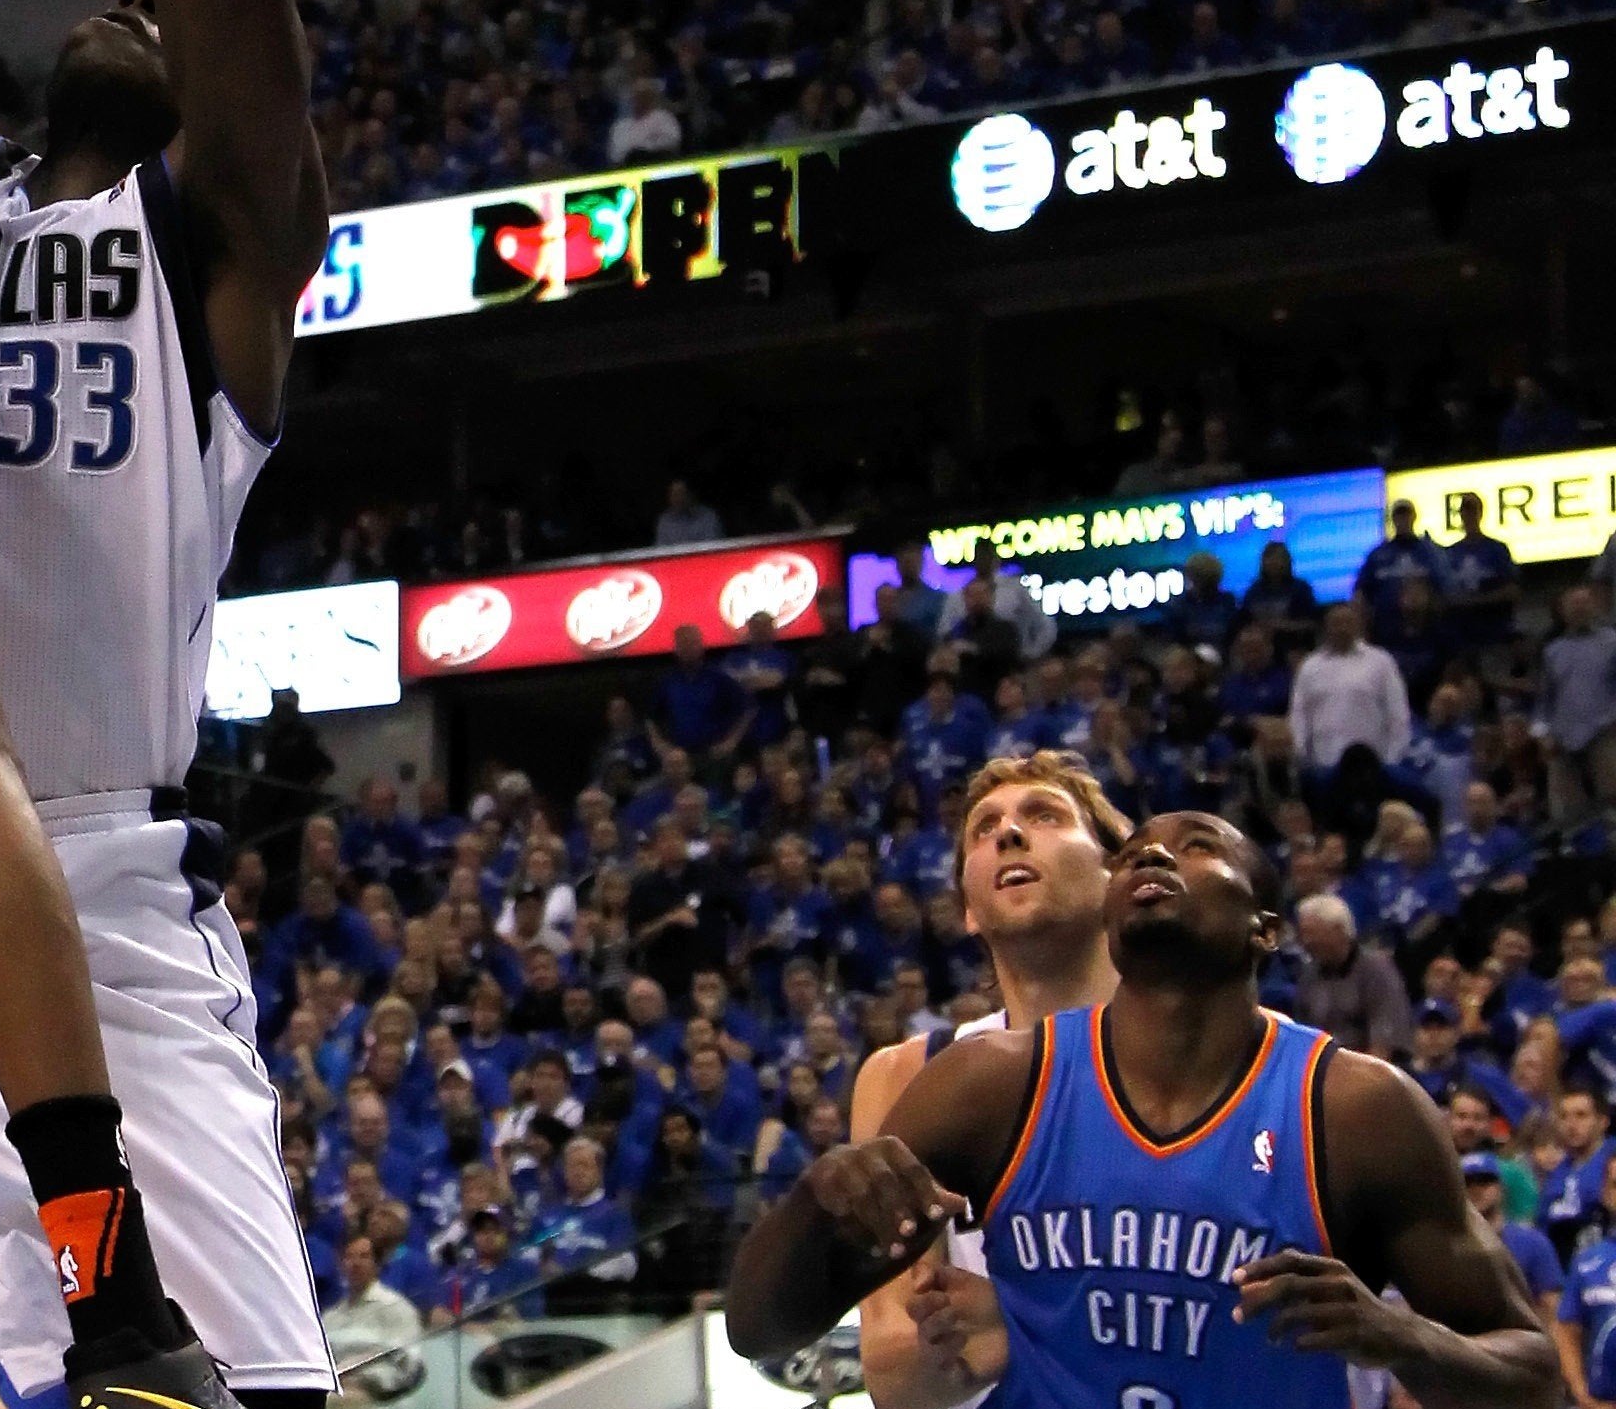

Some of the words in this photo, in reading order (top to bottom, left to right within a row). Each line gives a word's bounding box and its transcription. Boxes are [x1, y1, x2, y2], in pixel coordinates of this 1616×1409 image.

[1396, 46, 1570, 148] at&t
[1065, 98, 1226, 194] at&t
[1011, 1208, 1268, 1283] OKLAHOM
[1088, 1289, 1210, 1357] CITY
